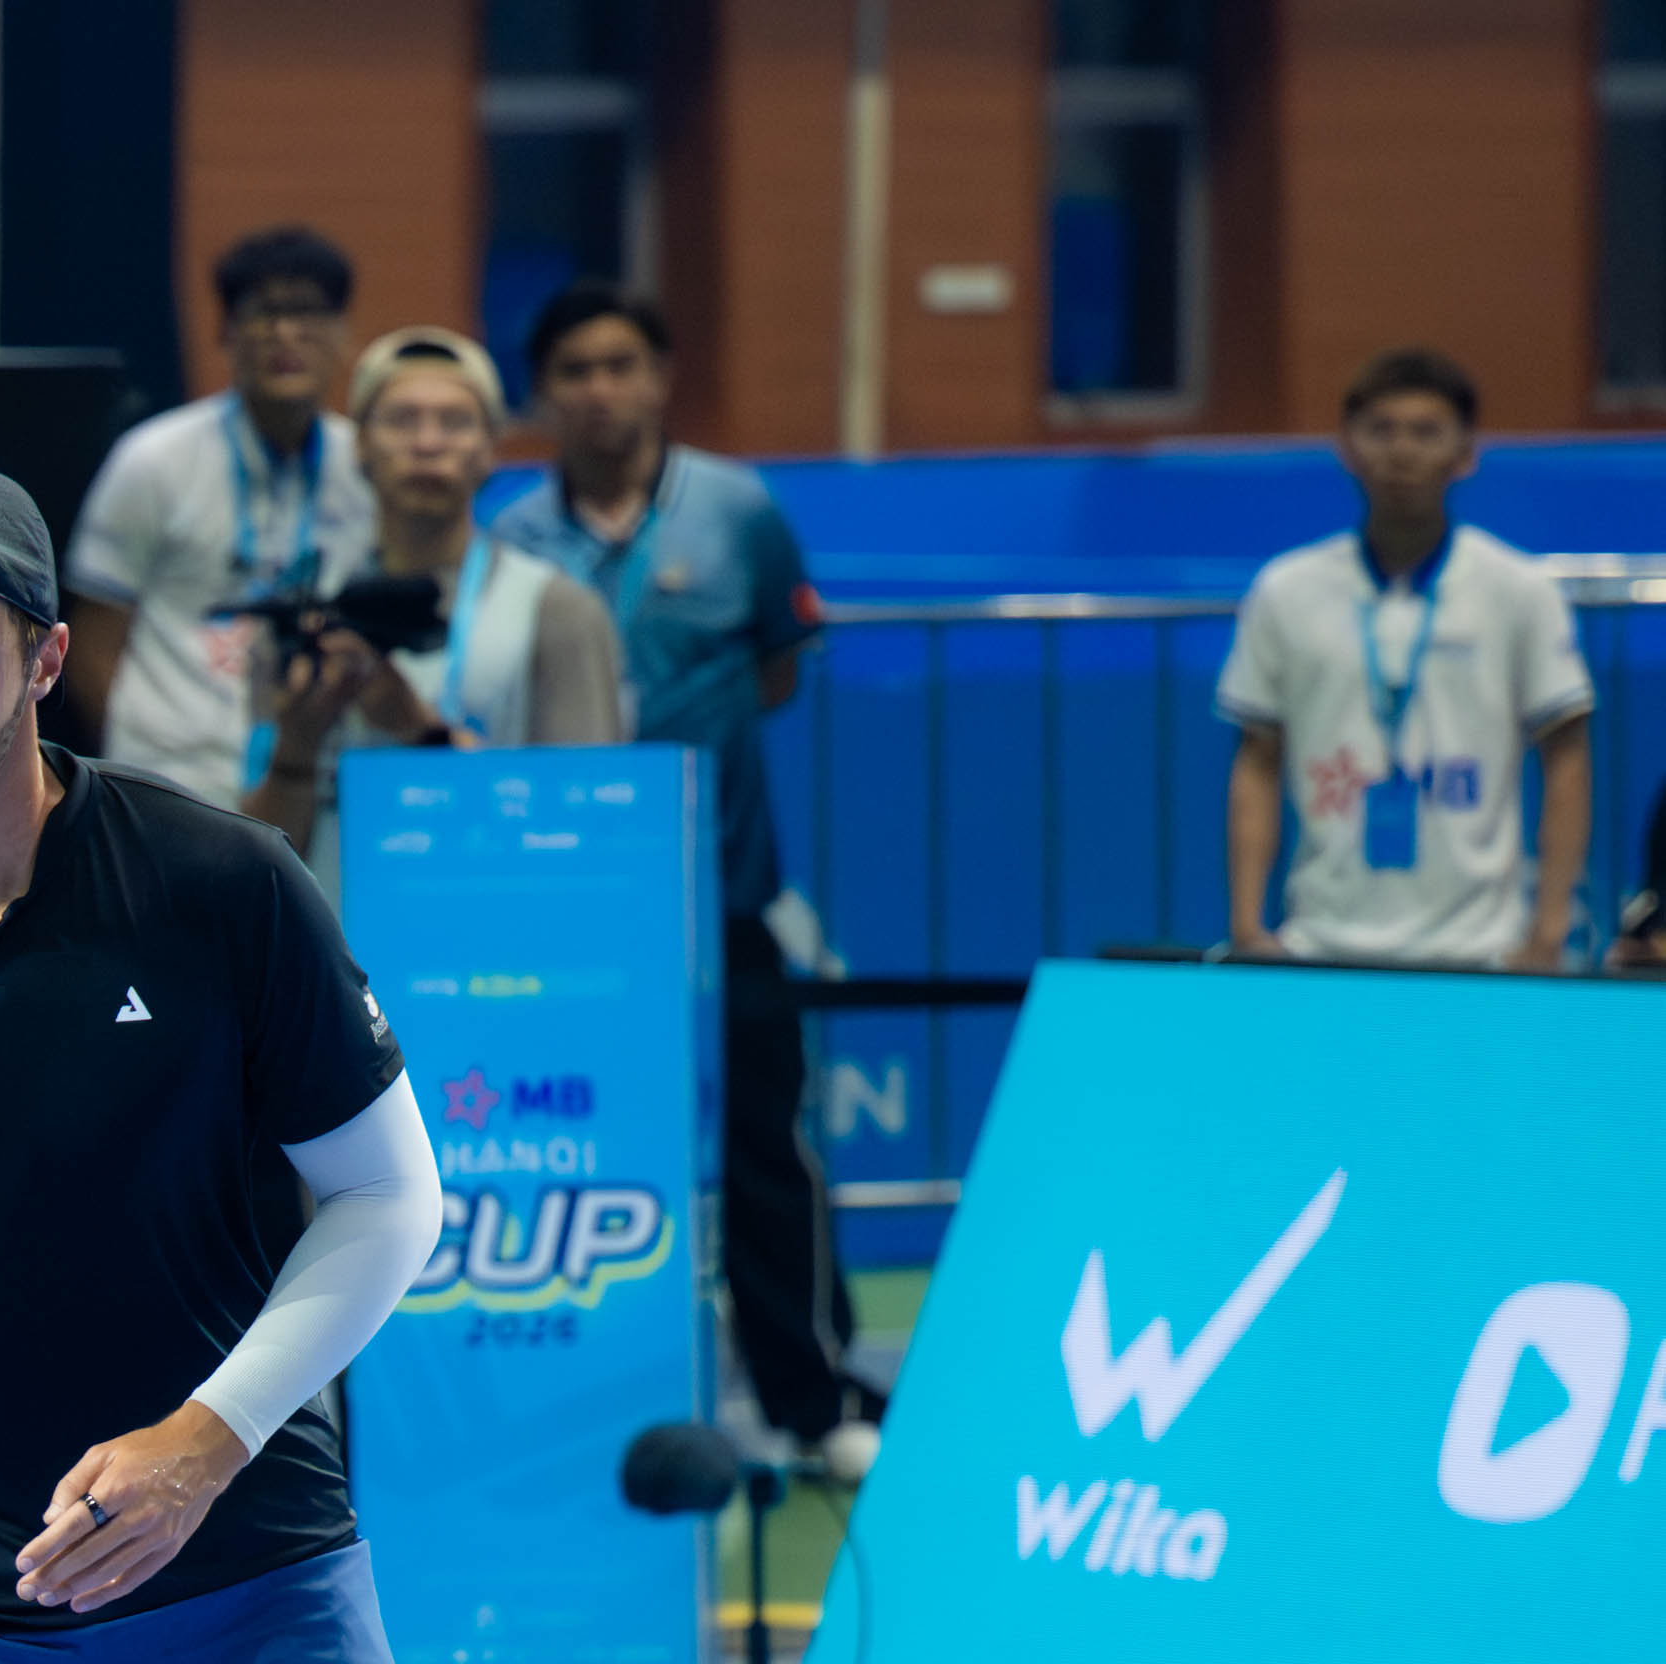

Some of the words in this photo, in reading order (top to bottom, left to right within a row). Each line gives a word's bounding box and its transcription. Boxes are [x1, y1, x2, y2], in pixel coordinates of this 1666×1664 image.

[510, 1077, 594, 1120] MB
[442, 1138, 597, 1177] HANOI
[1016, 1474, 1228, 1582] Wika
